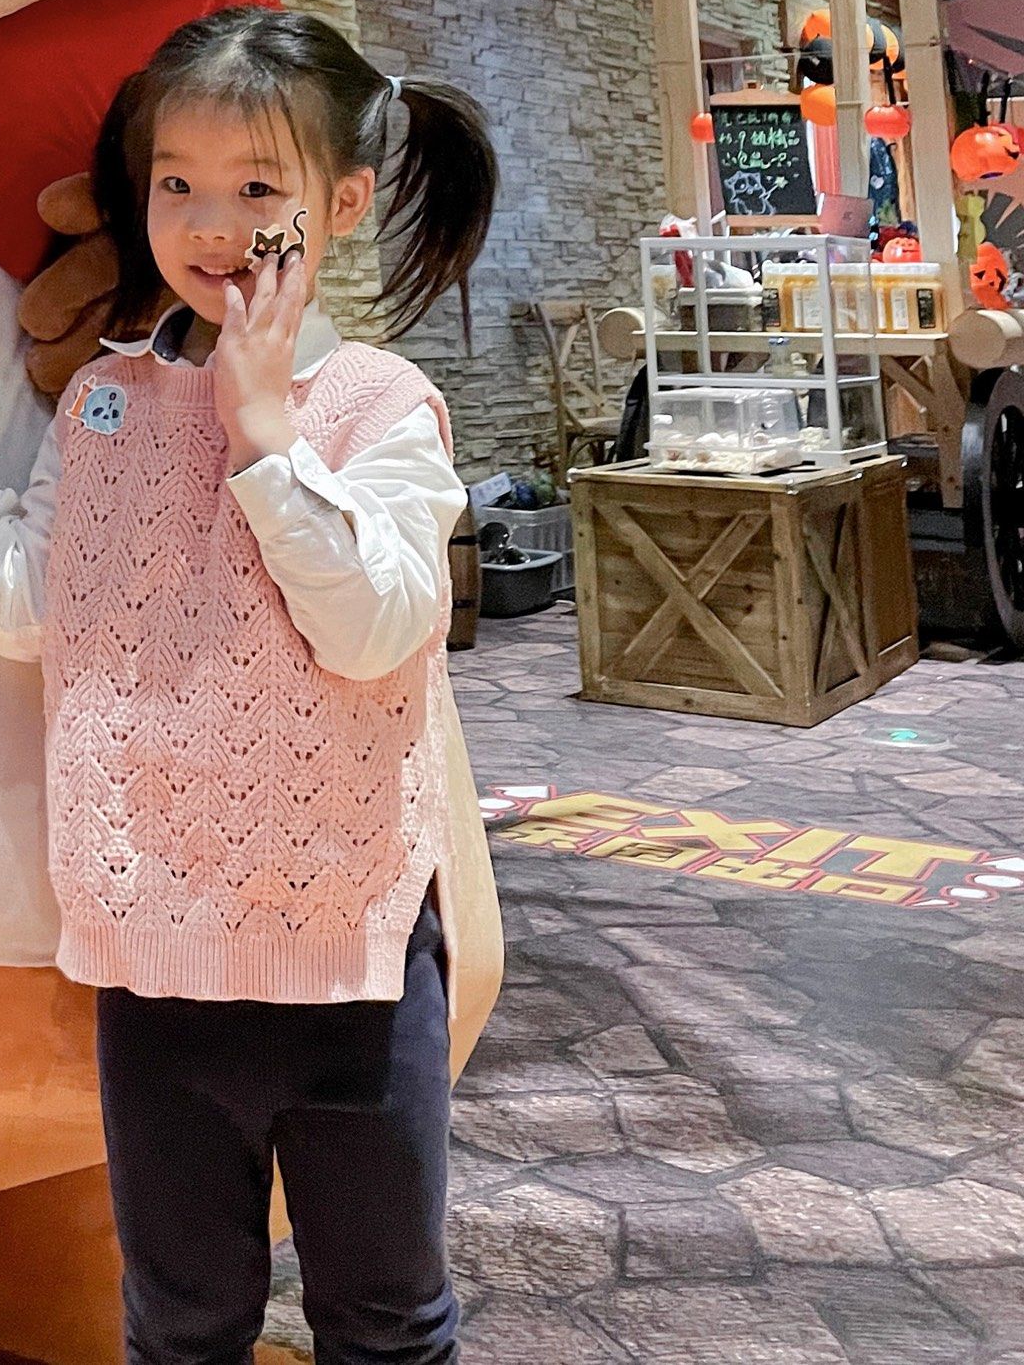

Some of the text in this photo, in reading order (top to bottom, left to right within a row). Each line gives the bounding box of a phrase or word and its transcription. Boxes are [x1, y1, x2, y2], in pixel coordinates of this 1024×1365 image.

[493, 820, 918, 902] 乐园出口
[527, 792, 979, 878] EXIT
